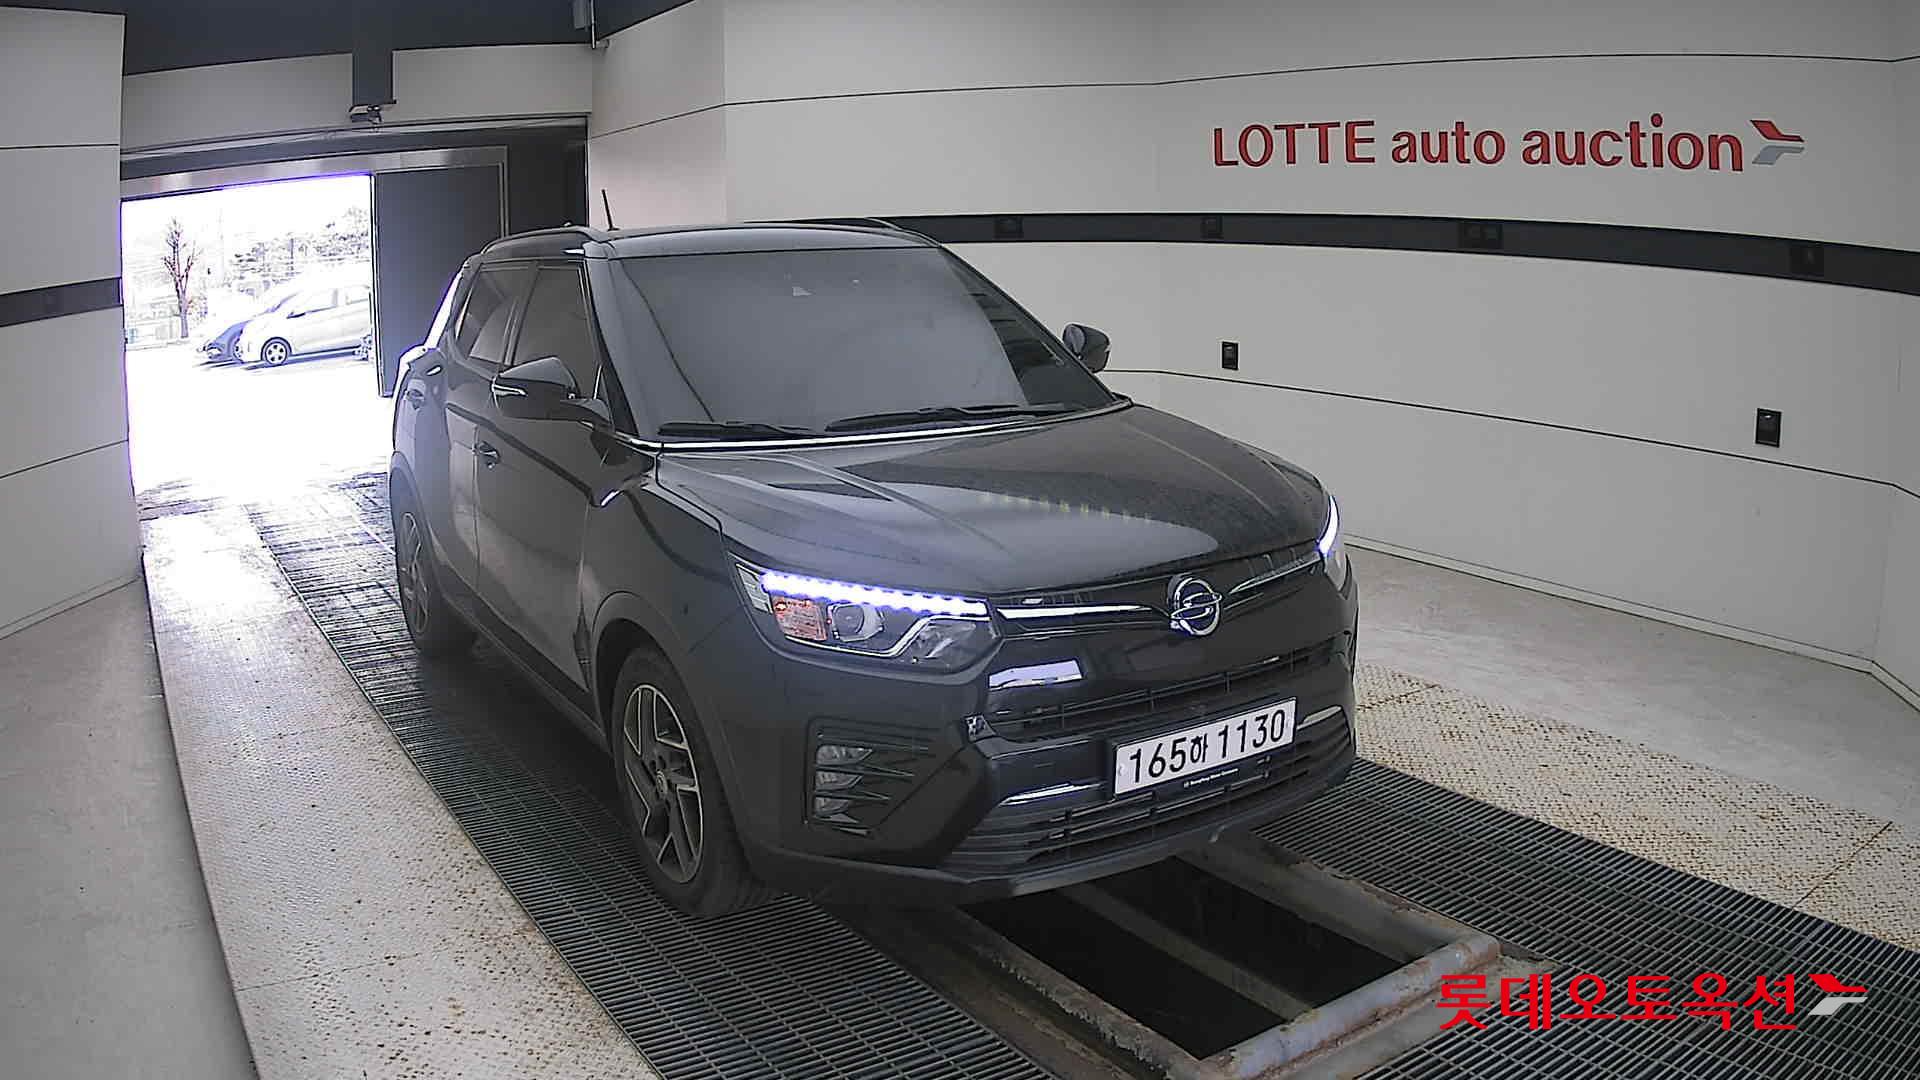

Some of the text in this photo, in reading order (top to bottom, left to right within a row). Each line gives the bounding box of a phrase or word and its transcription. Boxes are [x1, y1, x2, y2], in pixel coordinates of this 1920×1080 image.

[1213, 113, 1744, 172] LOTTE auto auction
[1130, 733, 1208, 783] 165하
[1218, 709, 1285, 758] 1130
